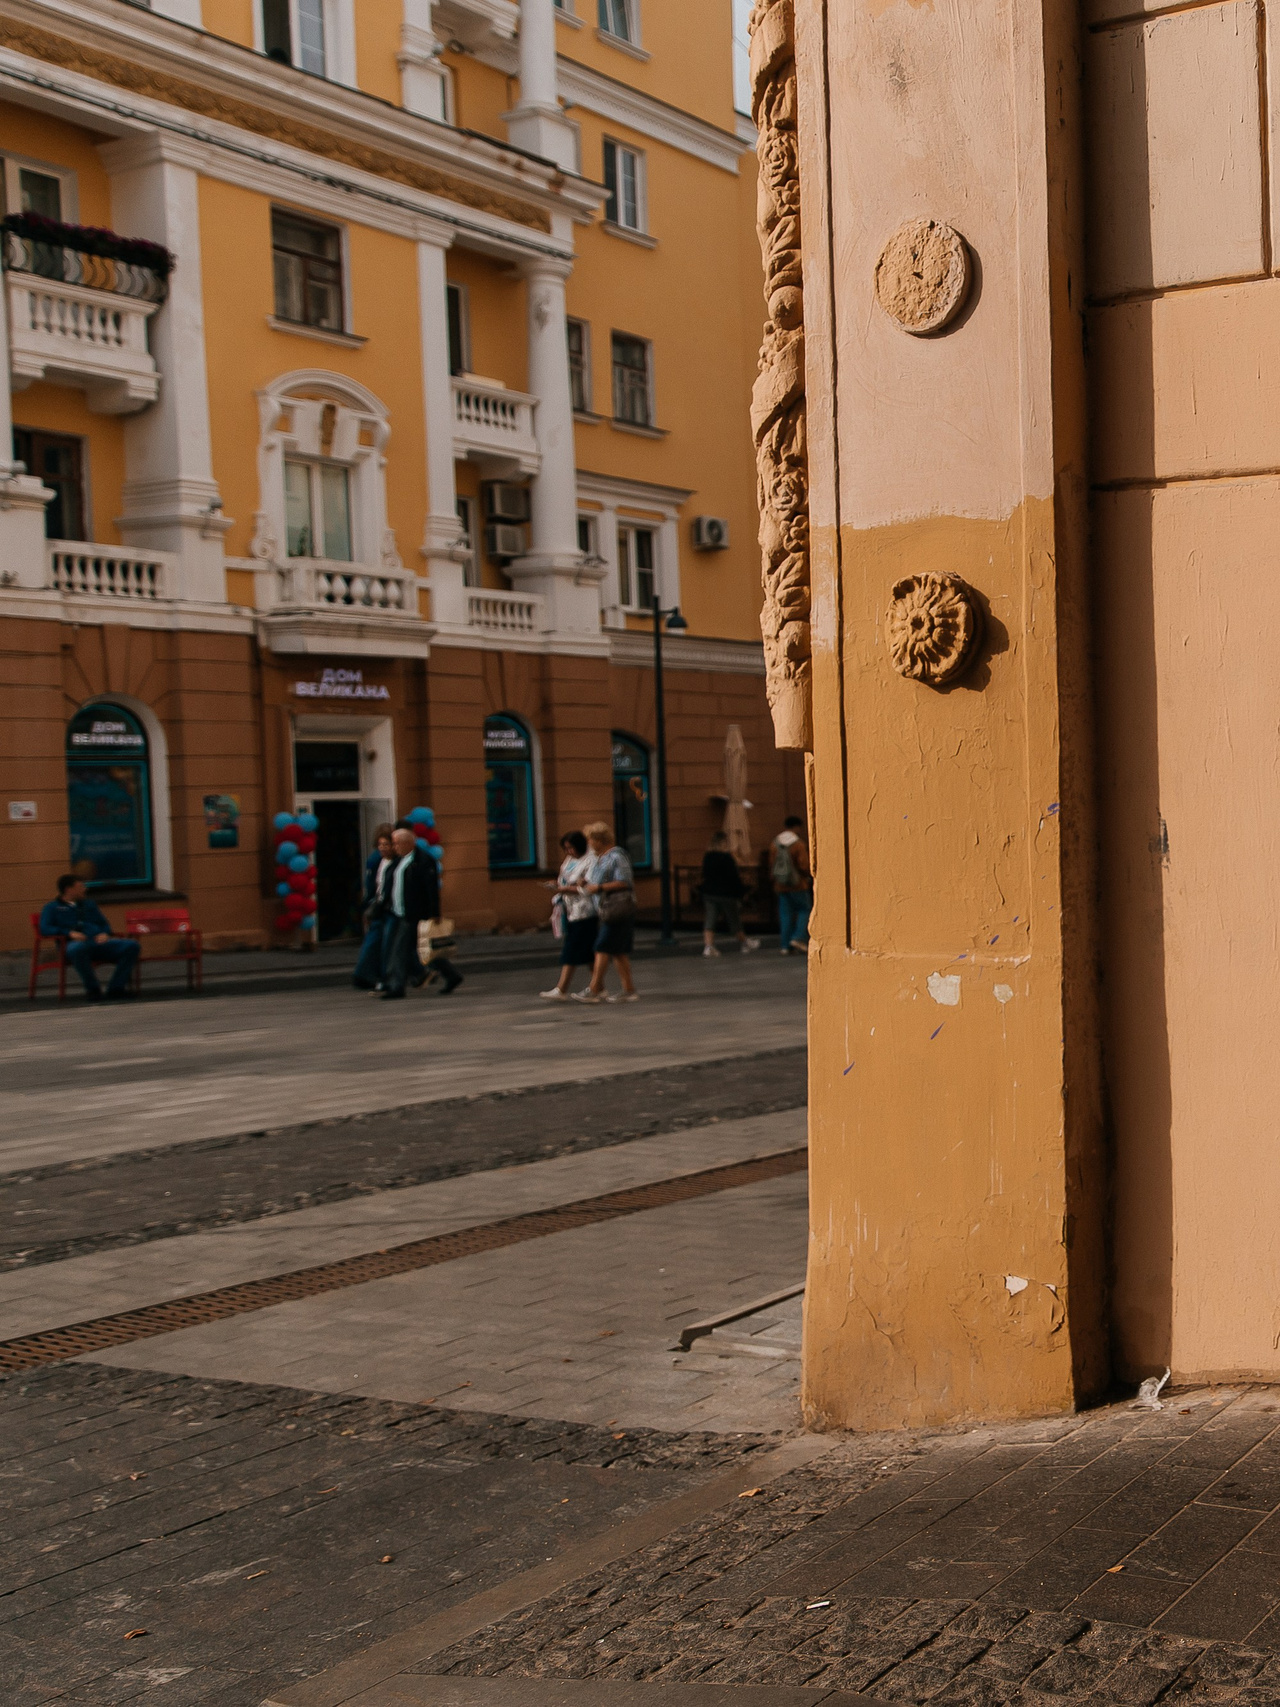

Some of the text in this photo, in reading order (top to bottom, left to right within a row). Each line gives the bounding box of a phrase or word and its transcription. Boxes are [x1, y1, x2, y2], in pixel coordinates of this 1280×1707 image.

[321, 668, 362, 682] ДОМ
[296, 682, 389, 698] ВЕЛИКАНА
[93, 721, 126, 732] ДОМ
[73, 733, 144, 745] ВЕЛИКАНА
